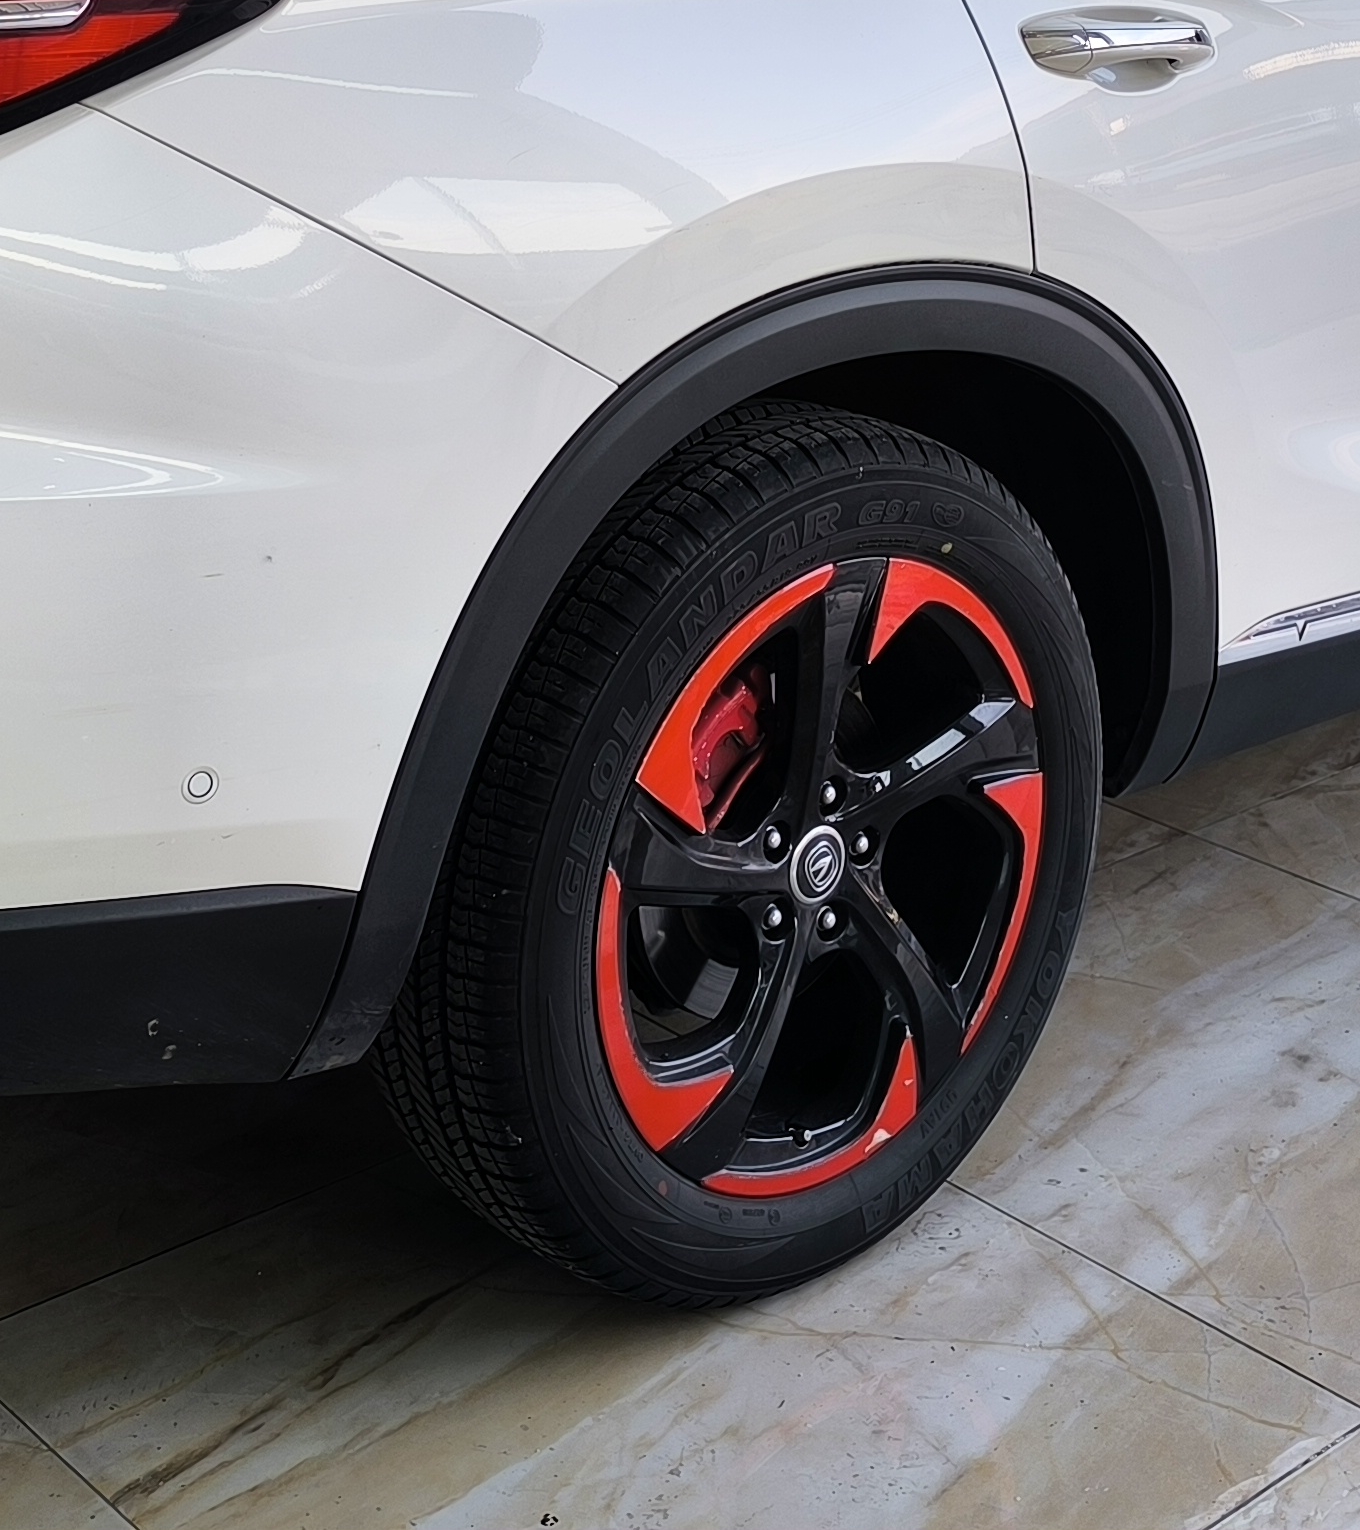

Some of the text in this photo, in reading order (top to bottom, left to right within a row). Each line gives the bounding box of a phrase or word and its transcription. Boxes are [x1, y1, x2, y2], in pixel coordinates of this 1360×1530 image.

[555, 499, 922, 915] GEOLANDAR G91
[859, 907, 1078, 1235] YOKOHAMA
